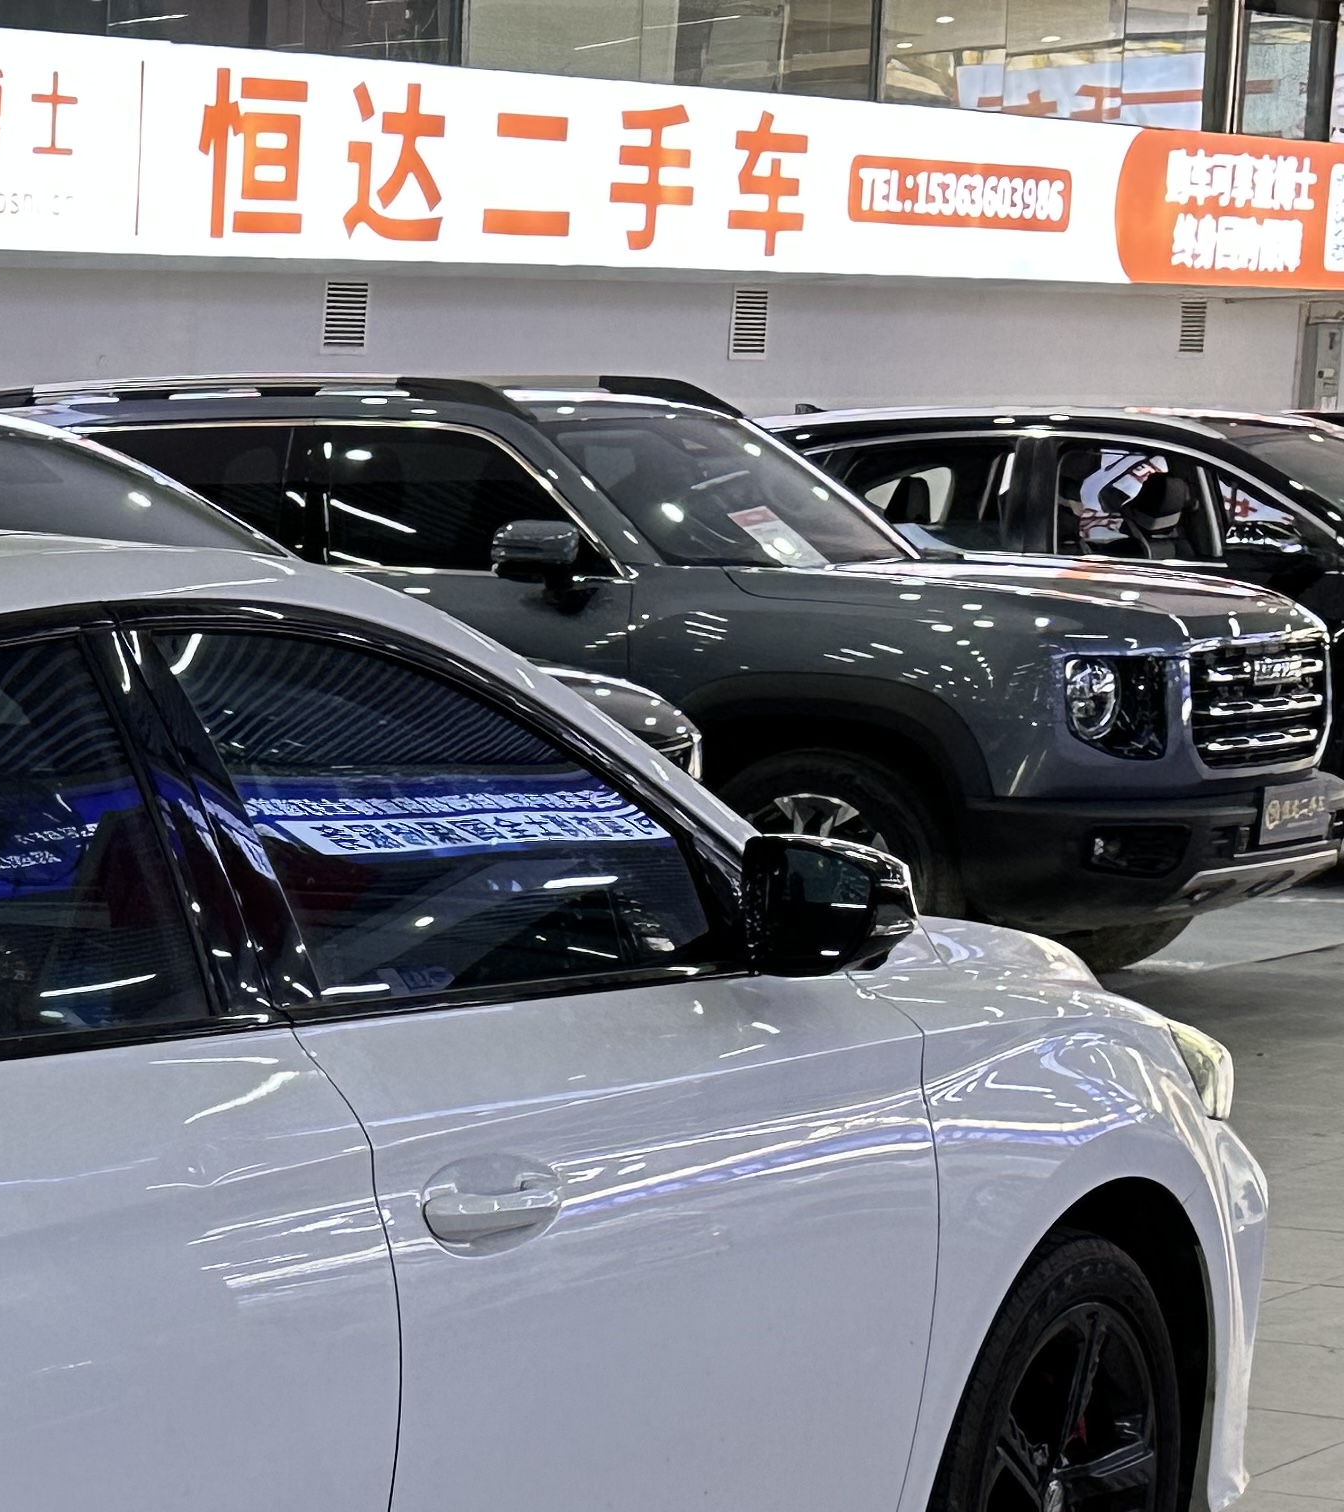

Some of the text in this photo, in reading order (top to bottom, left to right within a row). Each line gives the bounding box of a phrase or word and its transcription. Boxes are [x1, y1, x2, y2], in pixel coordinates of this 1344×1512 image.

[199, 67, 809, 258] 恒达二手车
